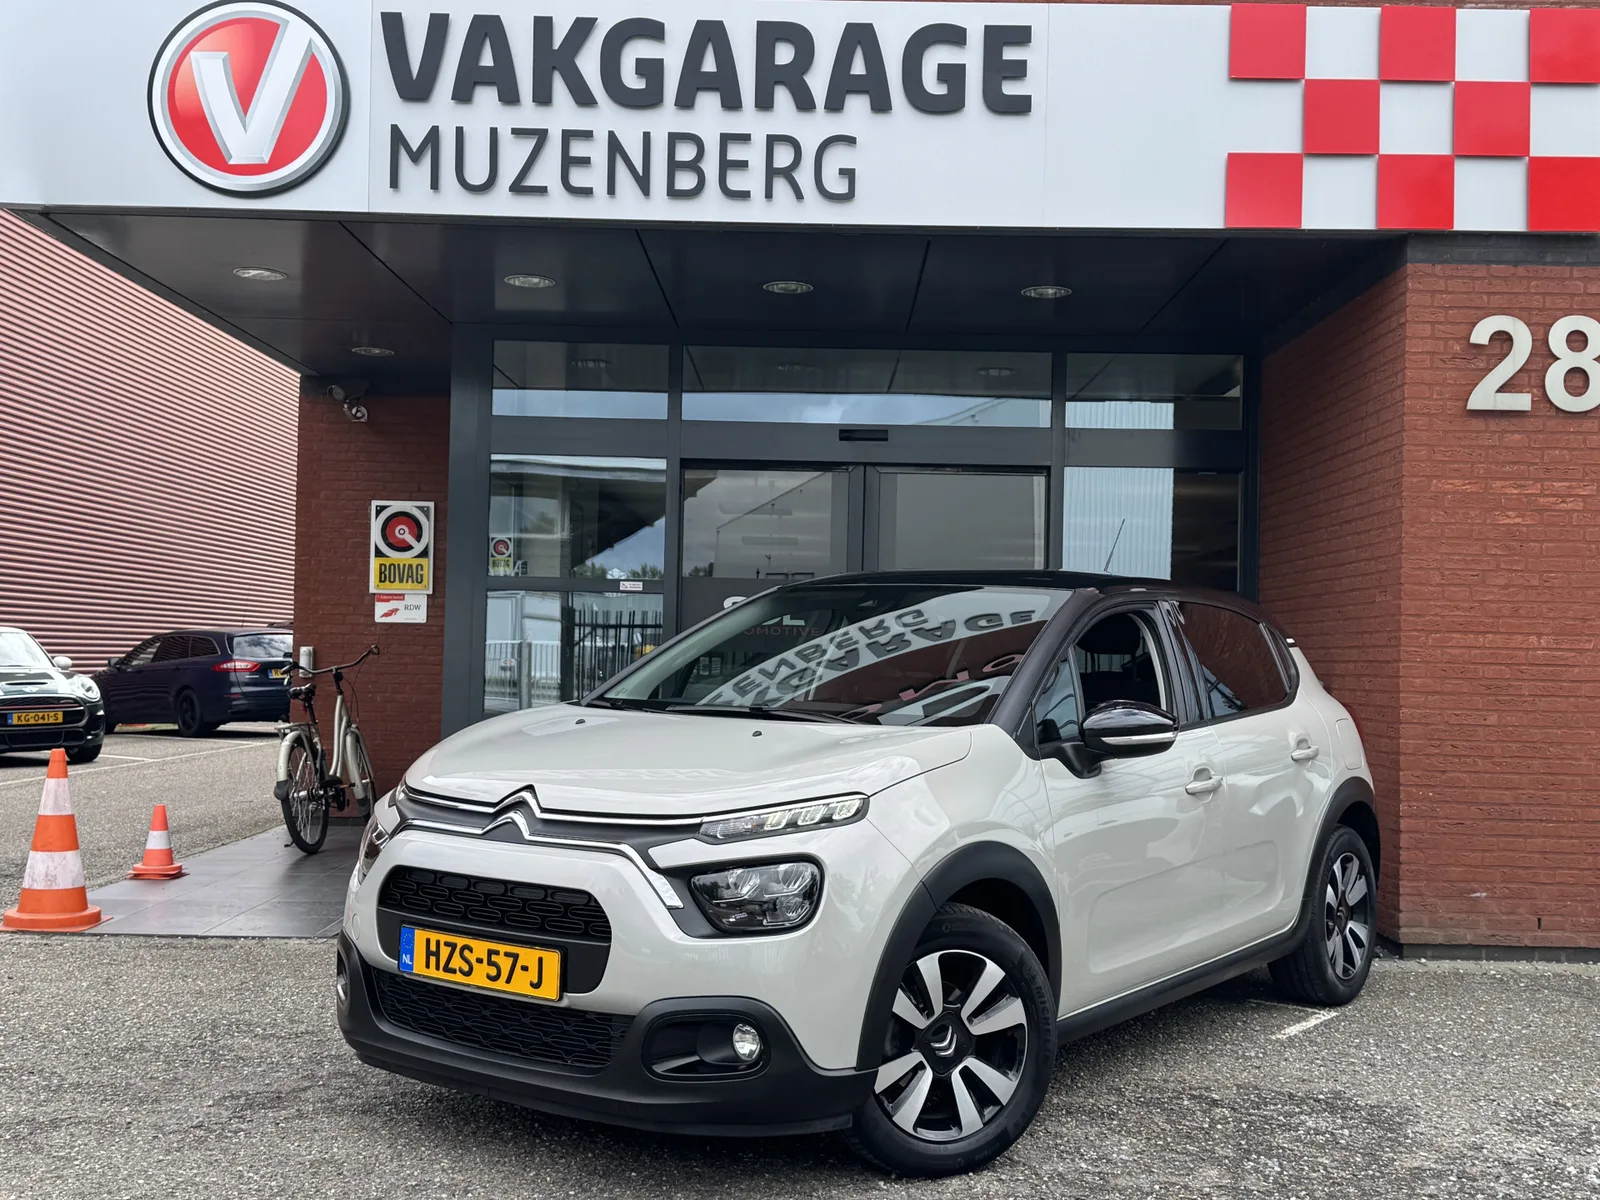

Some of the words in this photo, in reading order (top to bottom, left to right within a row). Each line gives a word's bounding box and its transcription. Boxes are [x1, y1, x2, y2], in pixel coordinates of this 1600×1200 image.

[380, 12, 1032, 115] VAKGARAGE
[389, 124, 857, 204] MUZENBERG
[1466, 315, 1600, 413] 28
[378, 563, 424, 584] BOVAG
[17, 713, 59, 723] KG-041-S
[402, 953, 413, 966] NL
[424, 936, 544, 990] HZS-57-J
